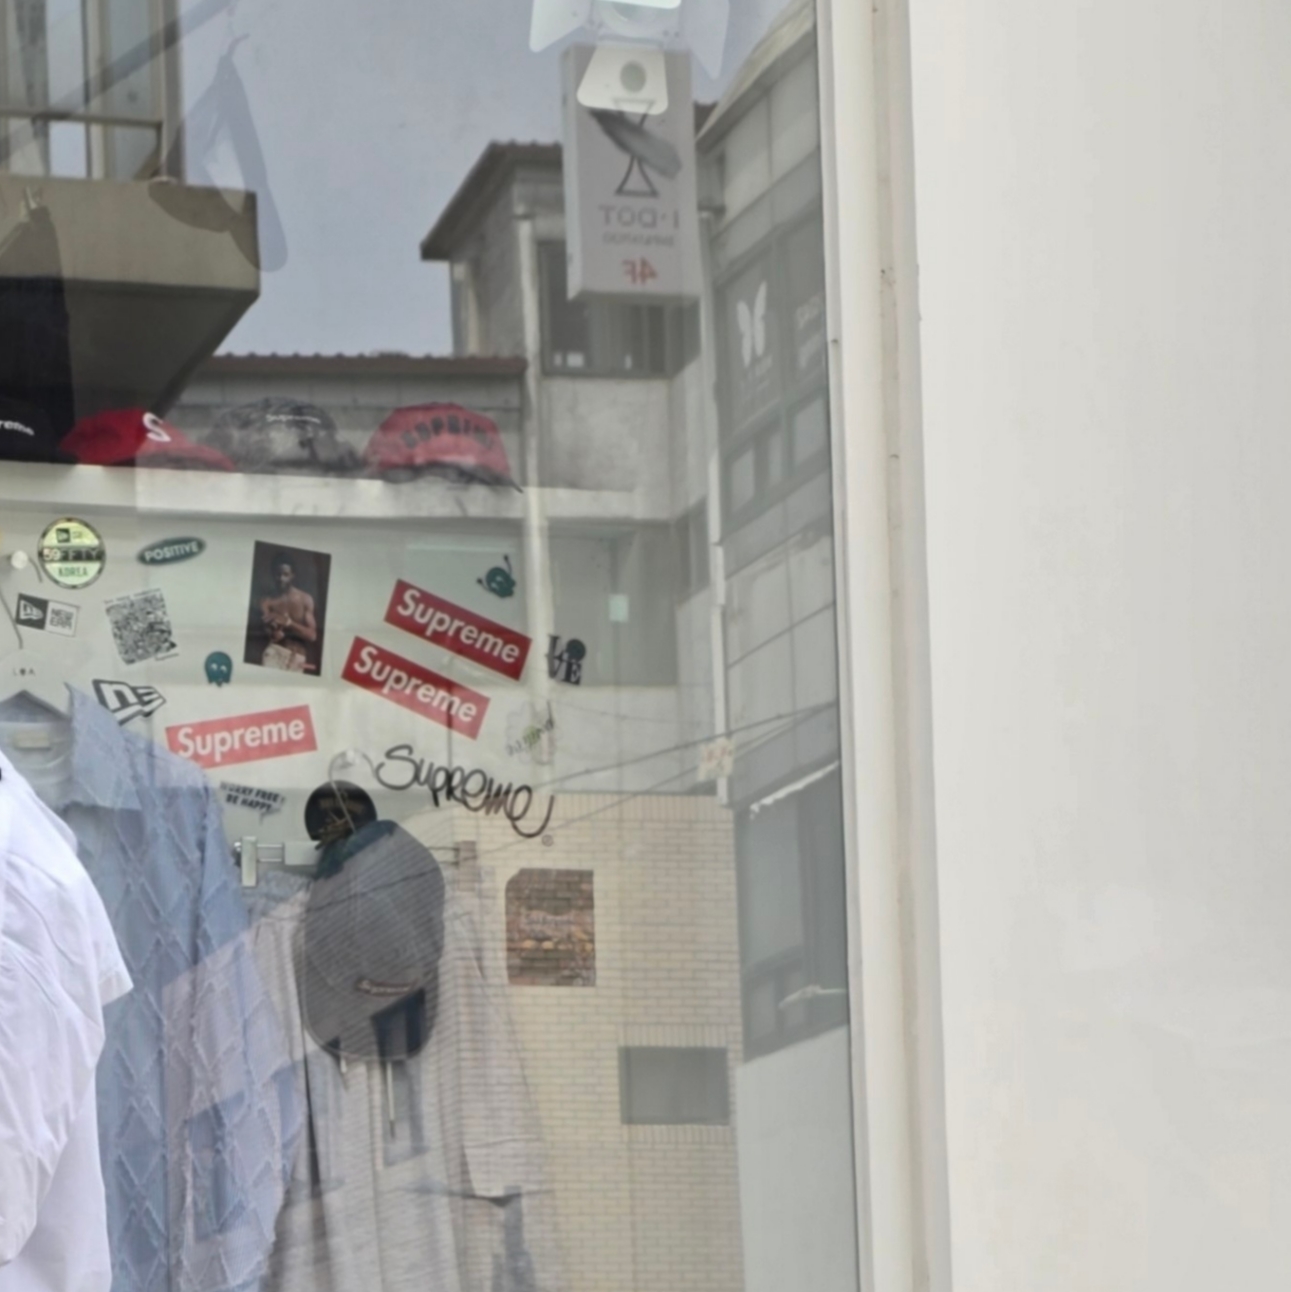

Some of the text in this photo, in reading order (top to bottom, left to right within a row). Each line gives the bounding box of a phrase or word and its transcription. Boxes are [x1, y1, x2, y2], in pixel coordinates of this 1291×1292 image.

[142, 412, 172, 443] S
[142, 541, 200, 563] POSITIVE
[58, 567, 89, 578] KOREA
[51, 608, 74, 620] NEW
[396, 587, 521, 665] Supreme
[352, 644, 478, 724] Supreme
[175, 711, 306, 760] Supreme
[225, 793, 273, 811] BE HAPPY
[255, 788, 281, 803] FREE
